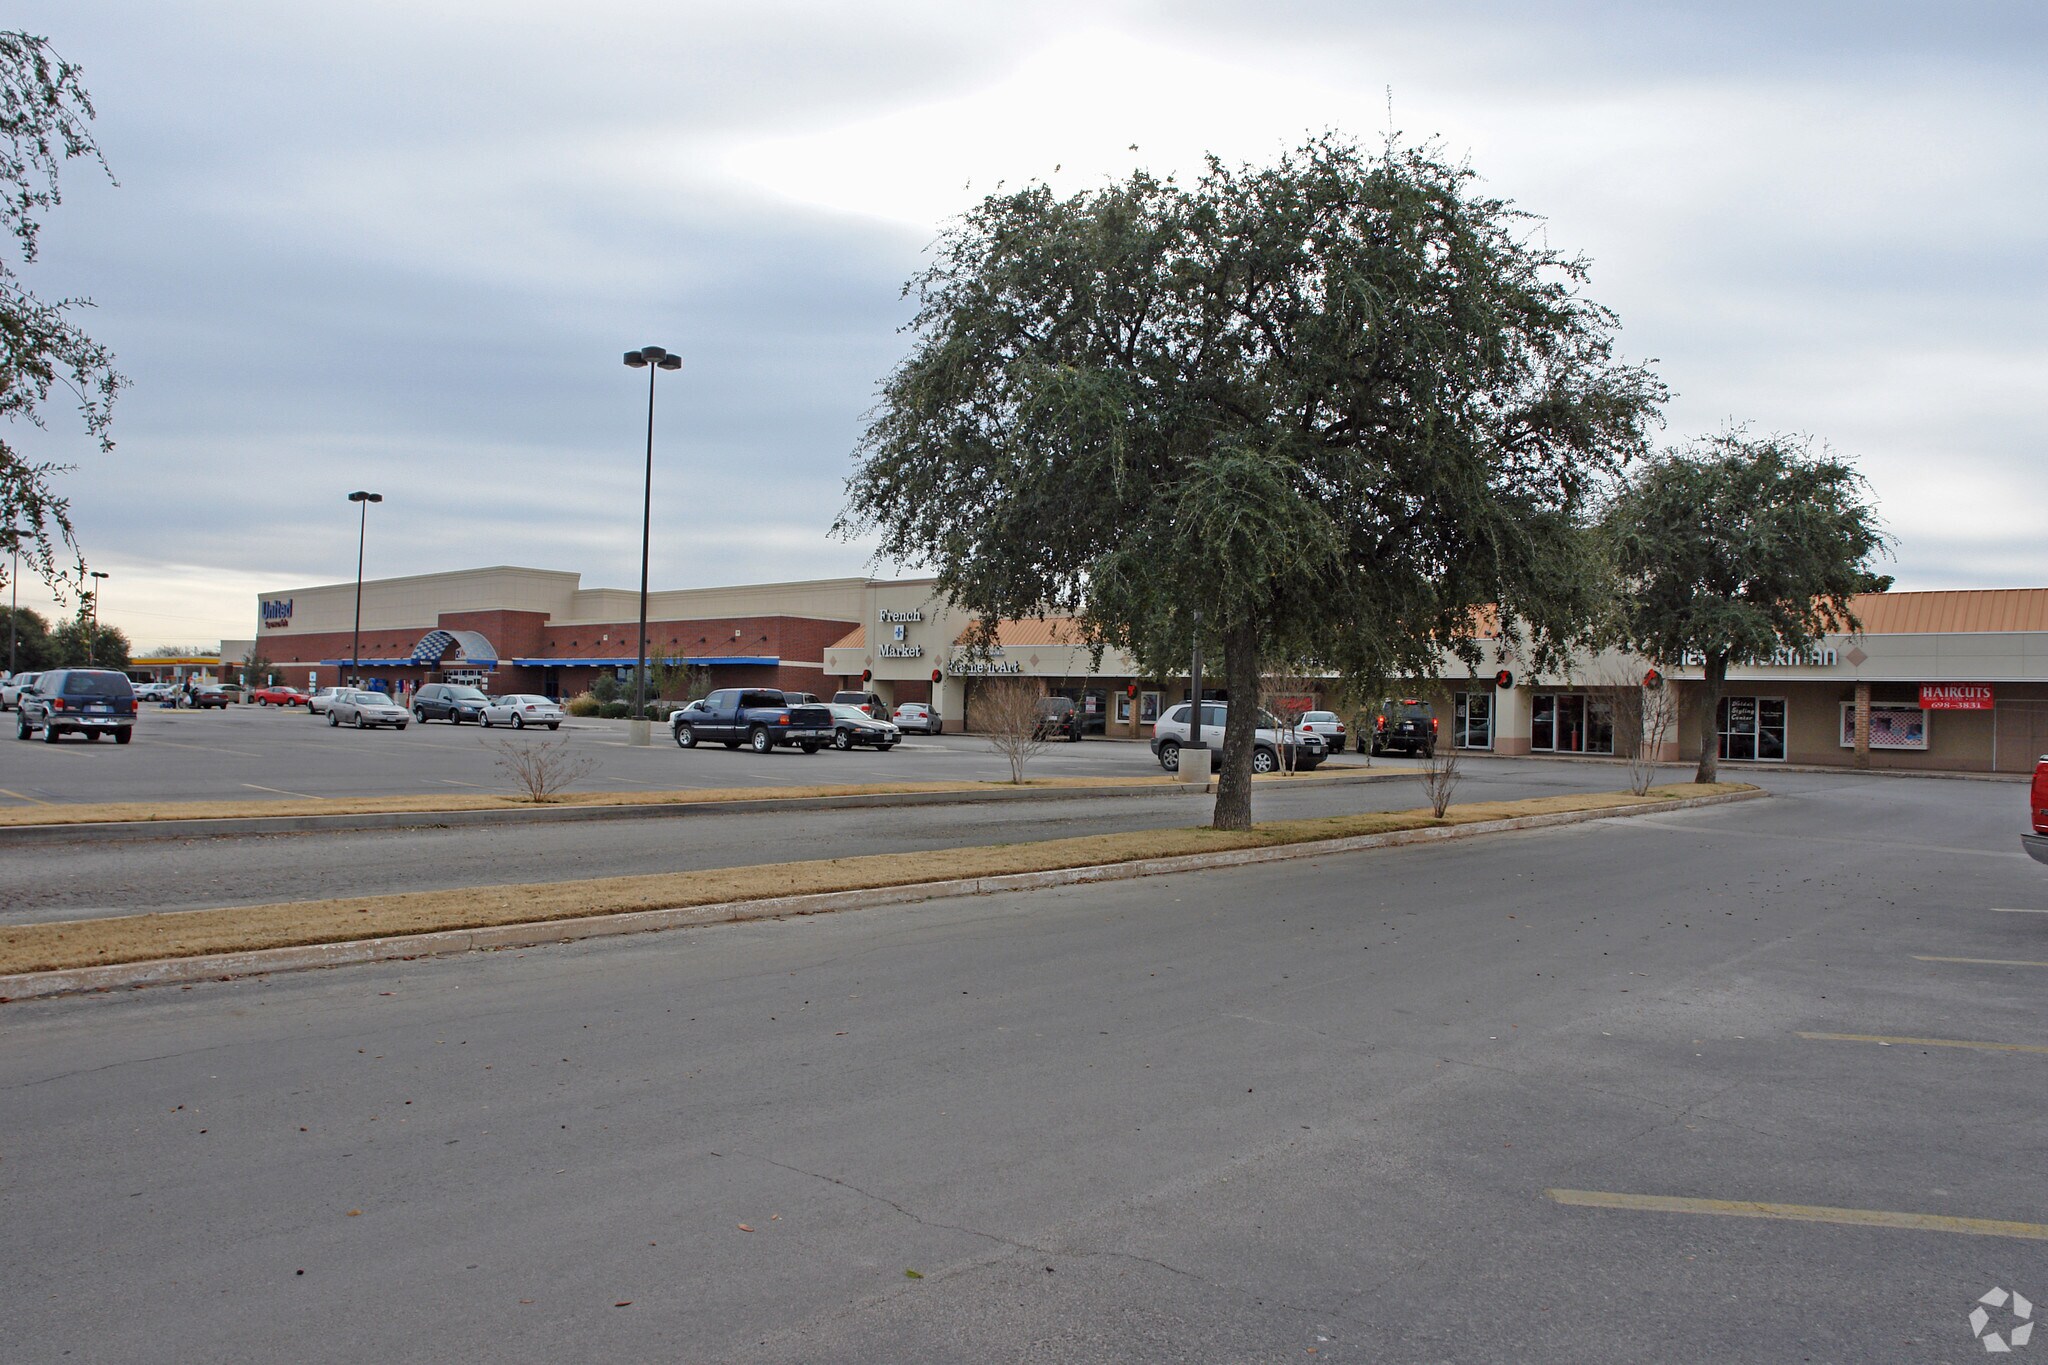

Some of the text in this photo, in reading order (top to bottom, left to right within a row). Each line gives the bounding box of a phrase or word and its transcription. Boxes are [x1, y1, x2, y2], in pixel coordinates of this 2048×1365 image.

[262, 599, 293, 619] United
[878, 608, 922, 623] French
[878, 643, 922, 657] Market
[998, 660, 1020, 673] Art
[1923, 687, 1990, 697] HAIRCUTS
